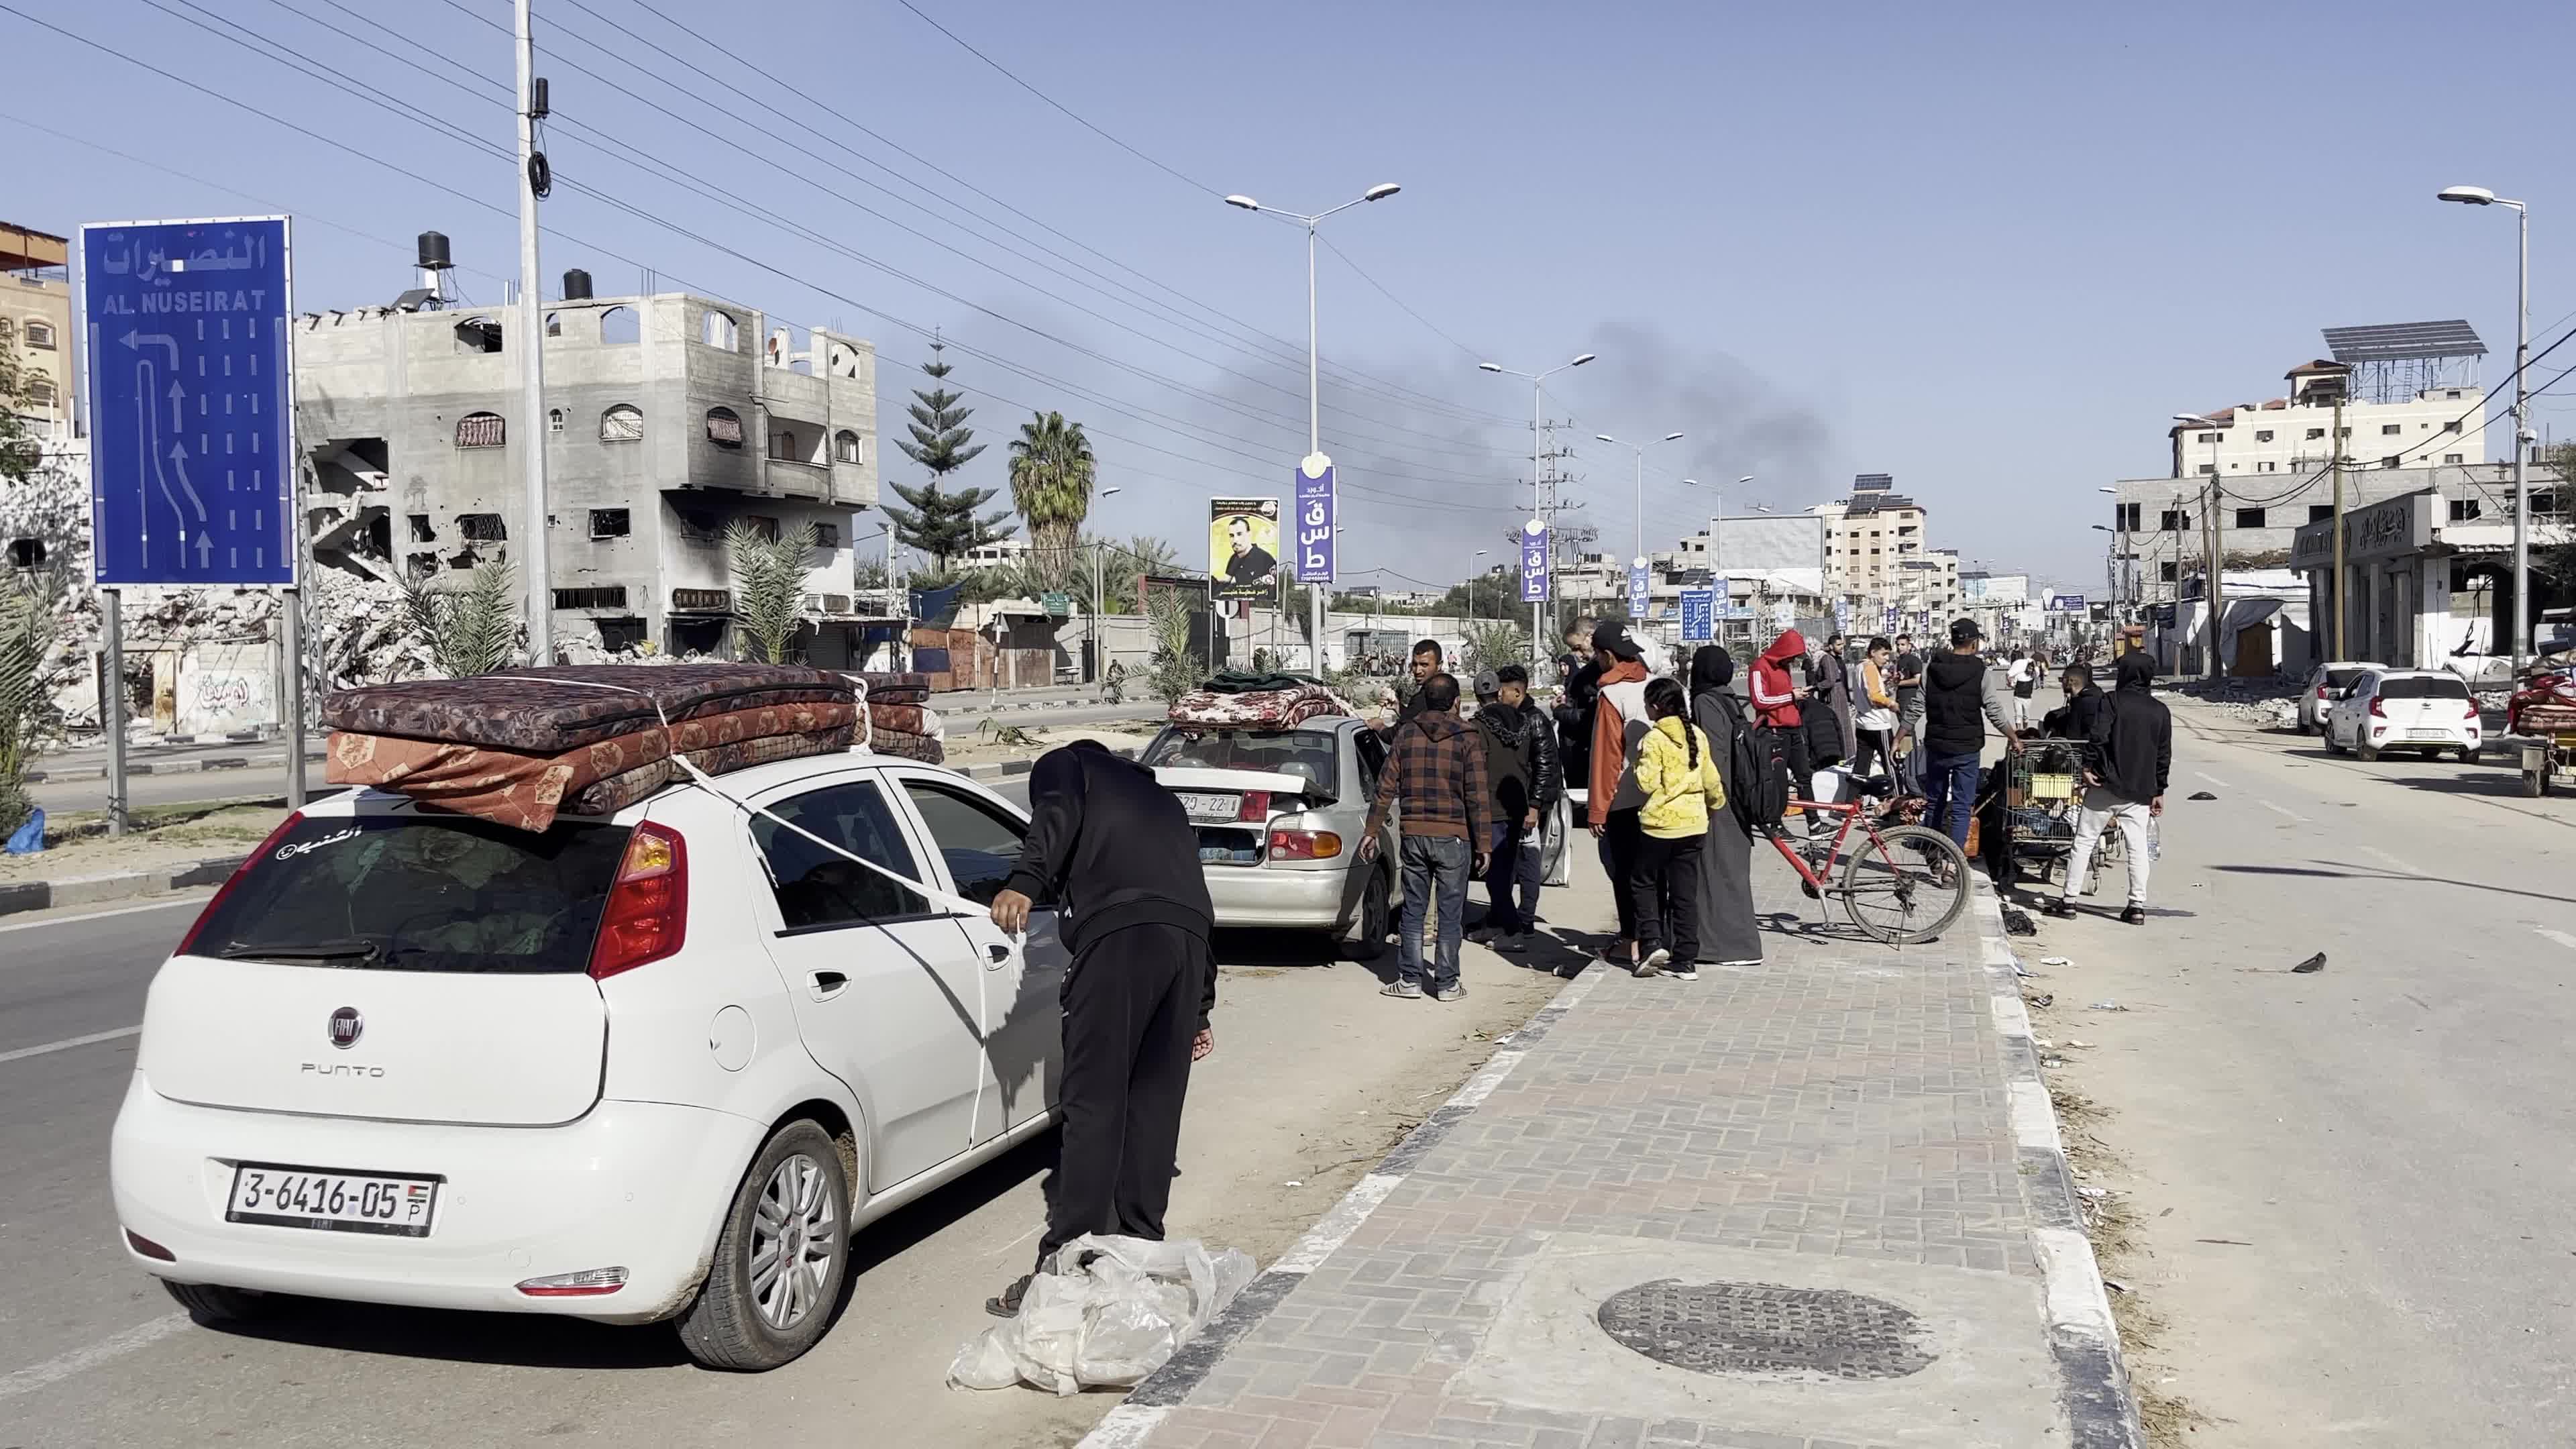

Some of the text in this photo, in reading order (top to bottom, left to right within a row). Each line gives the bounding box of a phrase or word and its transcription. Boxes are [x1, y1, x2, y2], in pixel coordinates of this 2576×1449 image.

[103, 229, 266, 287] النصيرات
[103, 289, 266, 315] AL NUSEIRAT
[334, 1018, 356, 1036] FIAT
[301, 1063, 386, 1078] PUNTO
[244, 1173, 421, 1222] 3-6416-05 P
